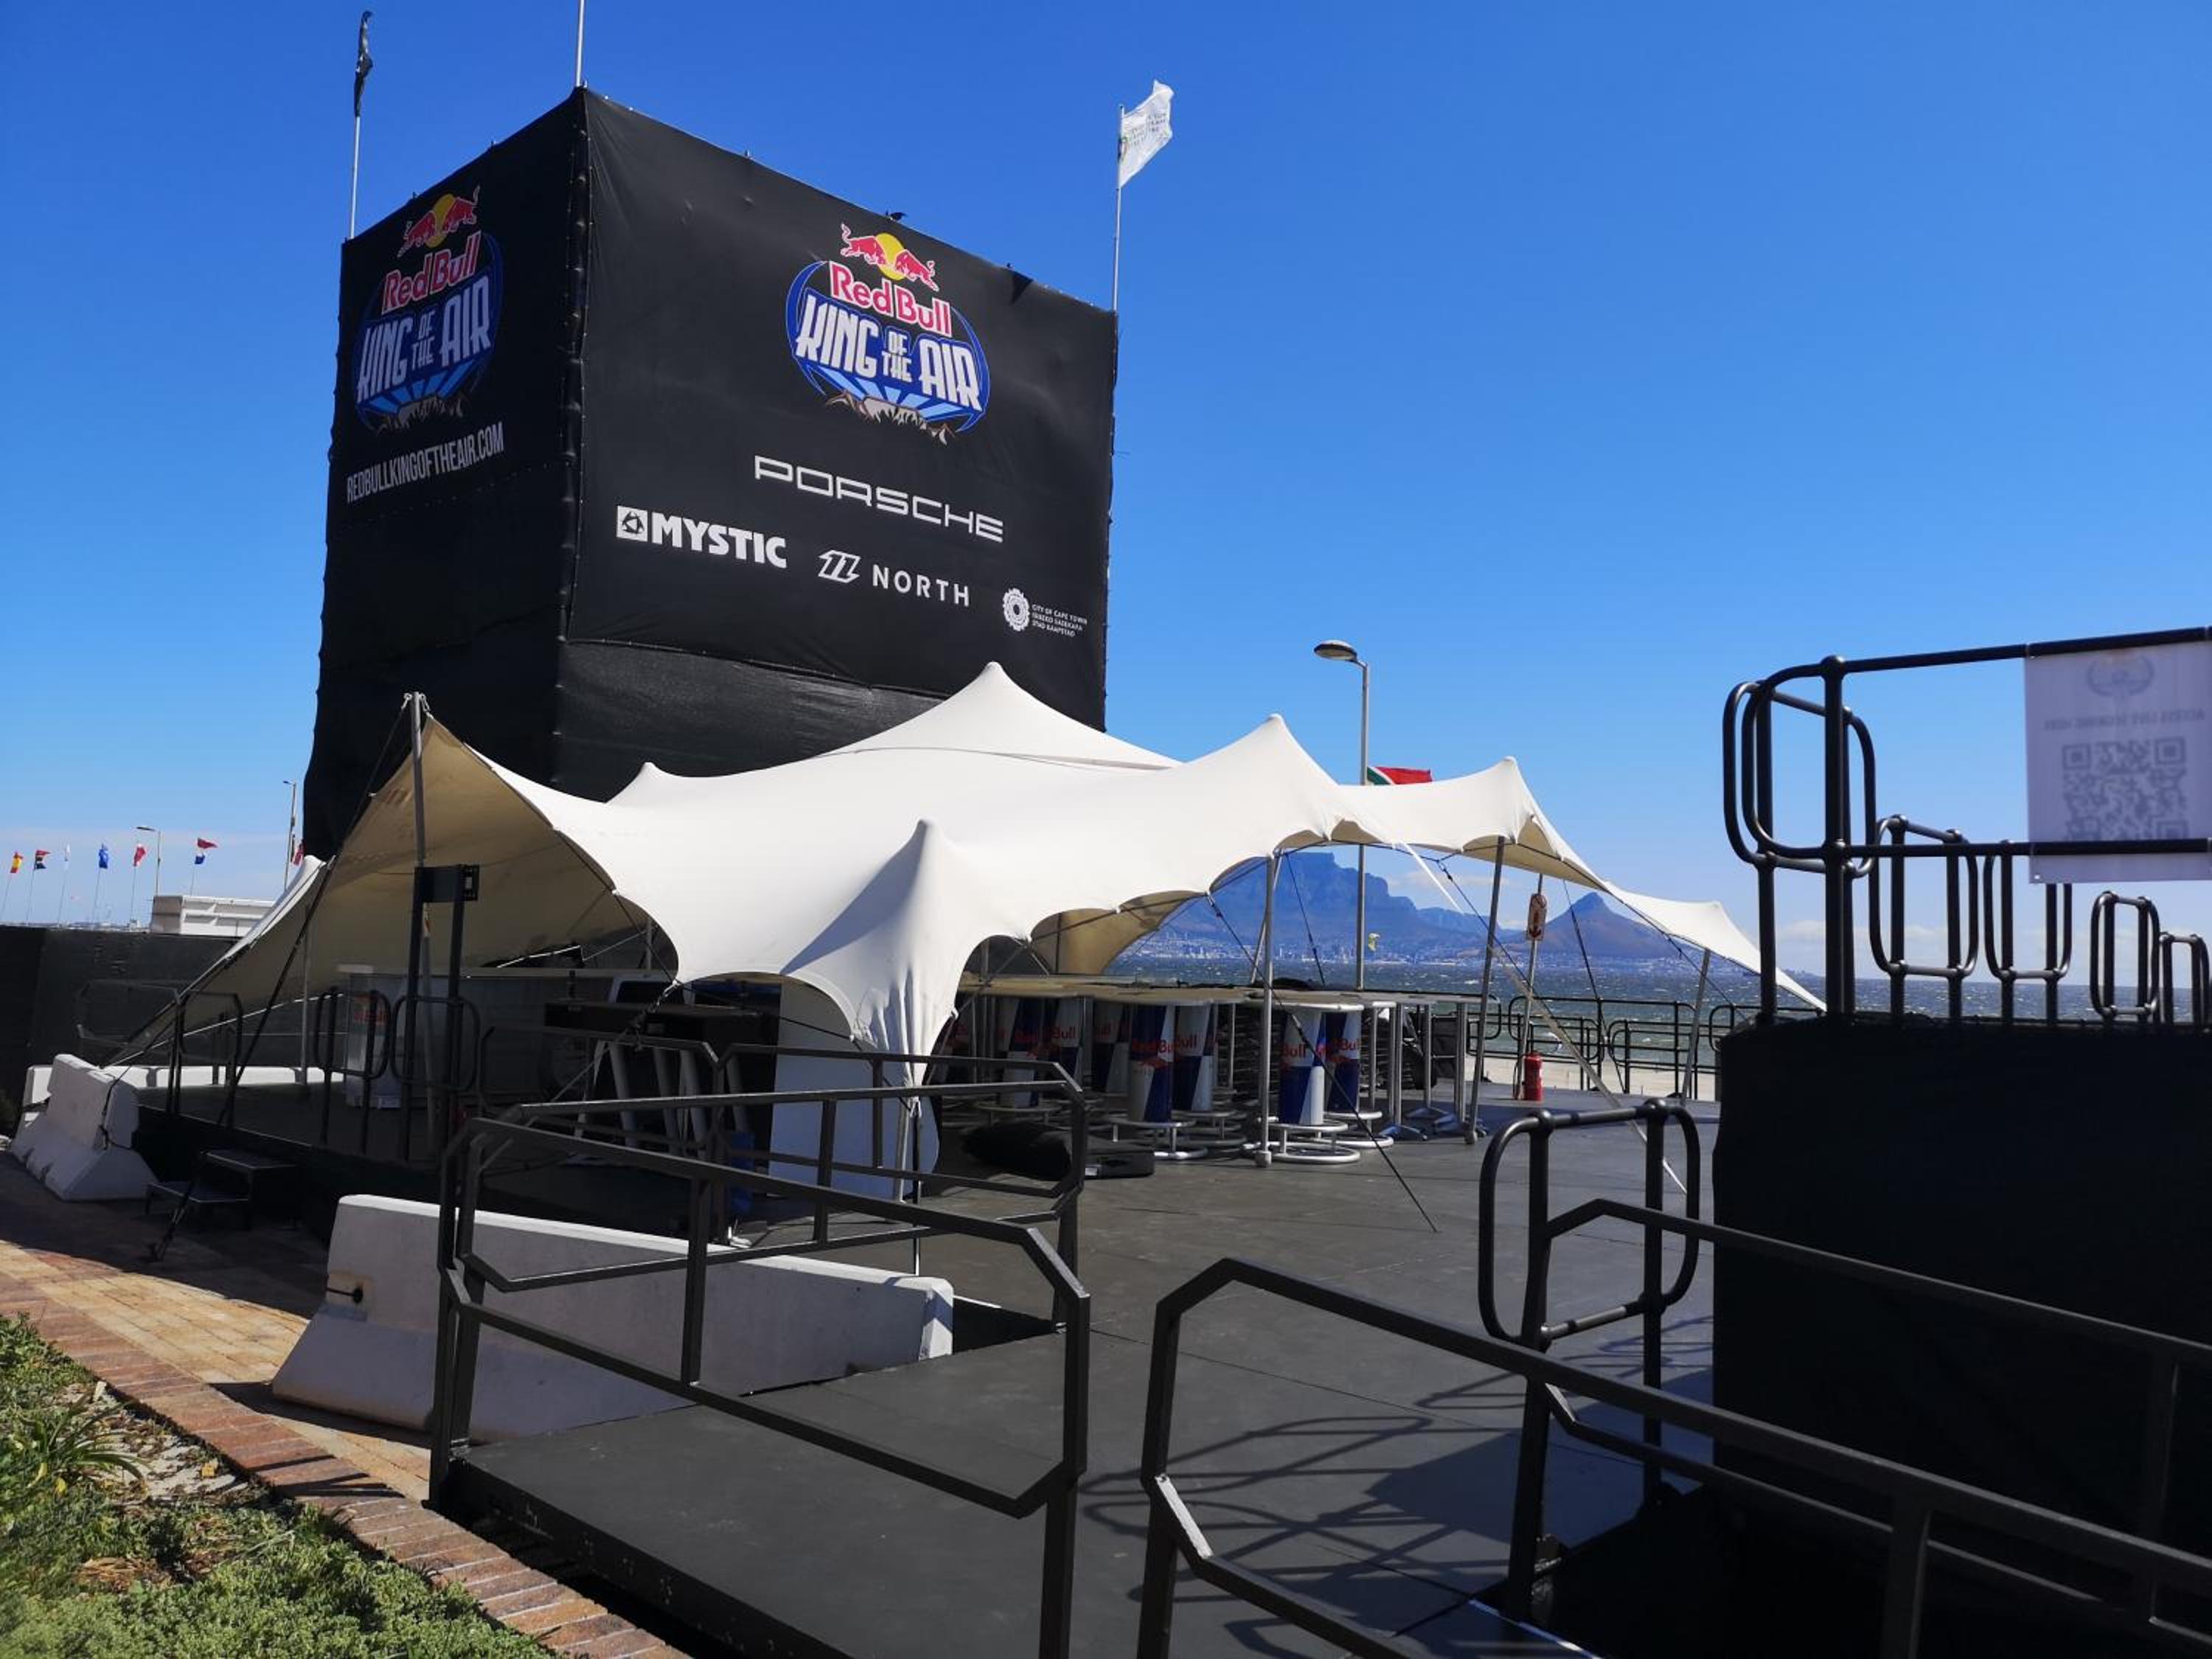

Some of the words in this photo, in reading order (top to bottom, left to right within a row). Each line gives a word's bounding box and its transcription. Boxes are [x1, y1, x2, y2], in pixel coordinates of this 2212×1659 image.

[382, 254, 430, 315] Red
[431, 230, 481, 291] Bull
[829, 260, 894, 317] Red
[896, 282, 953, 337] Bull
[411, 336, 435, 370] THE
[417, 310, 435, 340] OF
[439, 275, 492, 366] AIR
[796, 294, 880, 378] KING
[888, 330, 908, 355] OF
[357, 317, 413, 404] KING
[881, 350, 912, 382] THE
[918, 338, 983, 412] AIR
[347, 422, 504, 504] REDBULLKINGOFTHEAIR.COM
[754, 455, 1004, 543] PORSCHE
[652, 512, 787, 569] MYSTIC
[872, 563, 970, 607] NORTH
